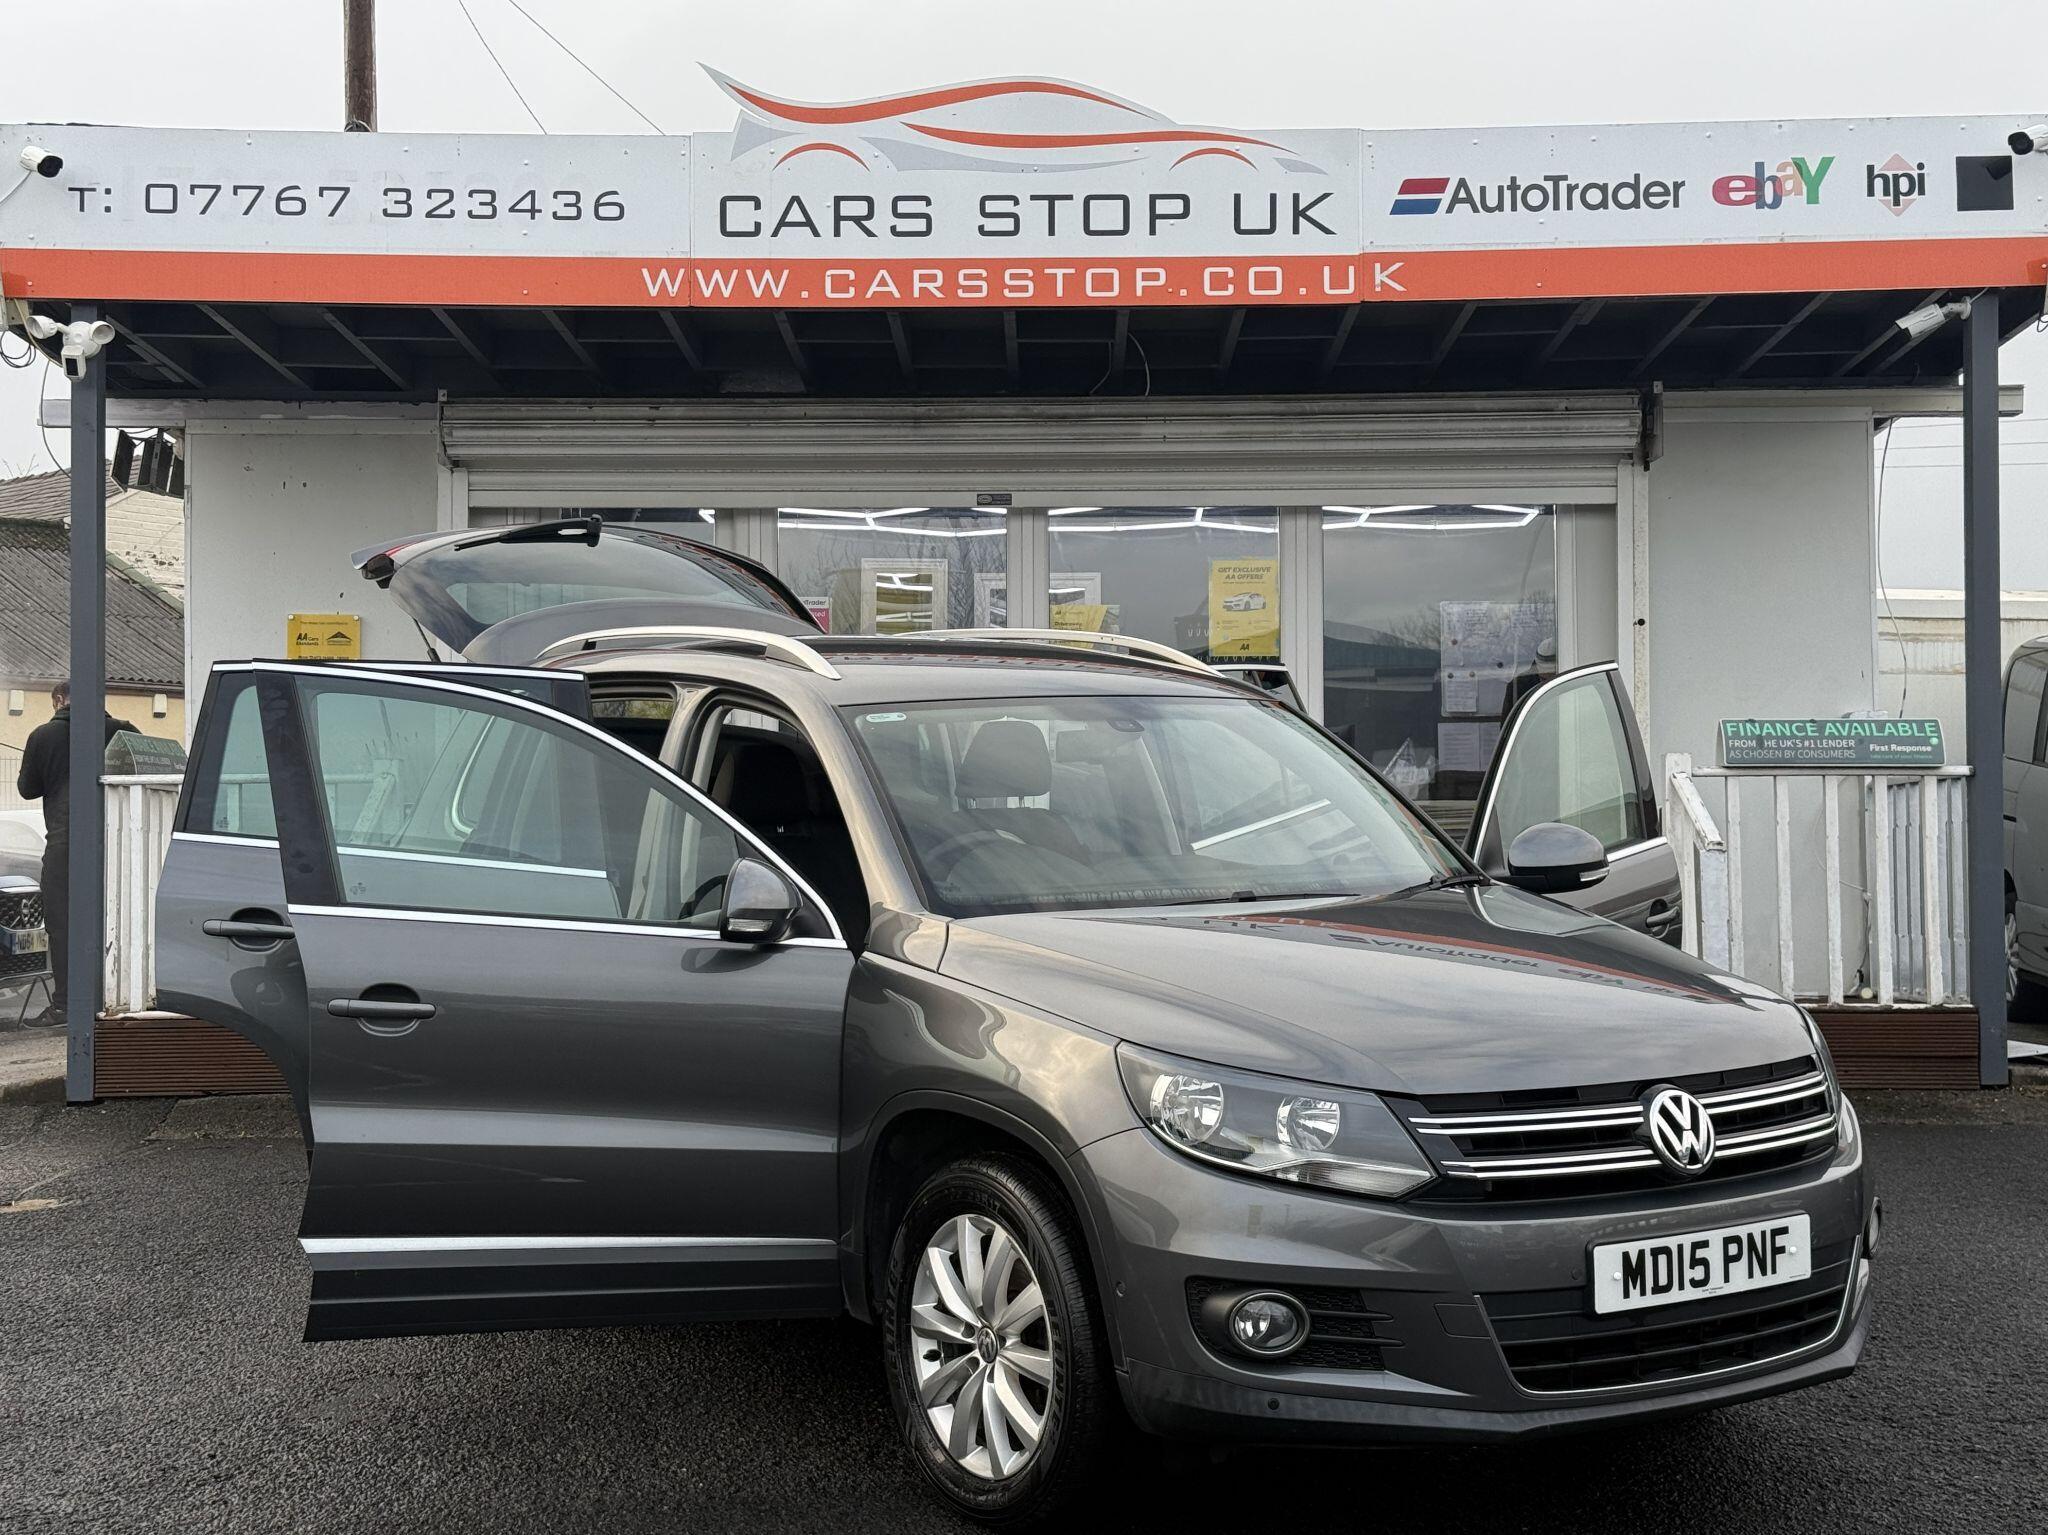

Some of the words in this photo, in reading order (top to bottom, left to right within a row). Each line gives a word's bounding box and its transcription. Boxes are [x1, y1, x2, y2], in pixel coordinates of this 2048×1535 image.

[1446, 173, 1686, 214] AutoTrader
[1866, 161, 1926, 207] hpi
[67, 186, 113, 213] T:
[145, 183, 351, 217] 07767
[382, 187, 625, 222] 323436
[719, 195, 933, 238] CARS
[977, 193, 1191, 237] STOP
[1233, 192, 1337, 236] UK
[641, 261, 1407, 299] WWW.CARSSTOP.CO.UK
[296, 632, 308, 641] AA
[1240, 643, 1249, 651] AA
[1726, 722, 1820, 737] FINANCE
[1824, 722, 1939, 737] AVAILABLE
[1728, 739, 1756, 748] FROM
[1779, 739, 1802, 748] UK'S
[1804, 739, 1815, 748] #1
[1817, 739, 1856, 748] LENDER
[1729, 749, 1742, 759] AS
[1743, 749, 1781, 759] CHOSEN
[1784, 749, 1796, 759] BY
[1797, 749, 1856, 759] CONSUMERS
[1869, 743, 1889, 752] First
[1890, 743, 1932, 753] Response
[1621, 1239, 1711, 1300] MD15
[1722, 1225, 1790, 1284] PNF
